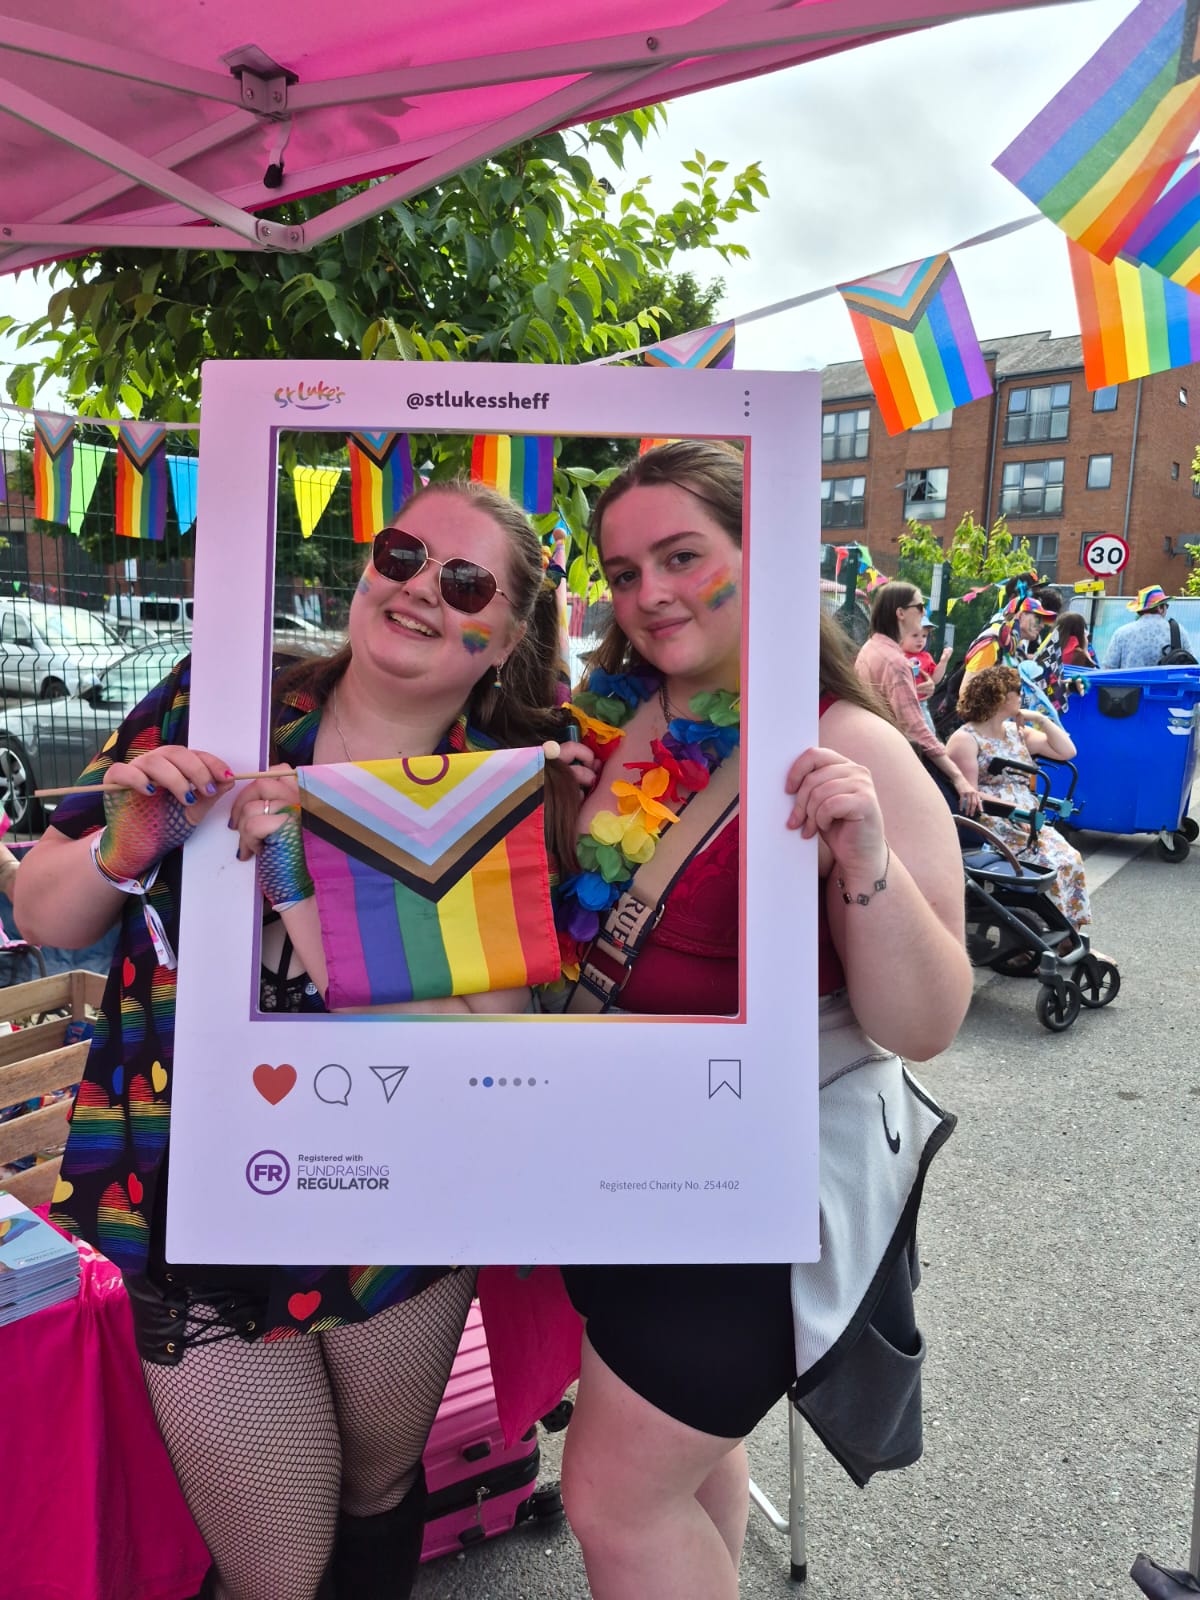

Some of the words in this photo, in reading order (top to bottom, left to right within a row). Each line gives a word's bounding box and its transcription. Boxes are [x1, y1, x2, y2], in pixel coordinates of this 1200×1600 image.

[274, 386, 295, 409] St
[298, 380, 346, 404] Luke's
[406, 390, 550, 410] @stlukessheff
[1090, 546, 1123, 565] 30
[298, 1153, 343, 1163] Registered
[345, 1154, 364, 1162] with
[254, 1164, 283, 1182] FR
[297, 1165, 390, 1177] FUNDRAISING
[297, 1177, 390, 1190] REGULATOR
[600, 1180, 647, 1193] Registered
[649, 1180, 683, 1193] Charity
[685, 1180, 701, 1190] No.
[703, 1180, 740, 1190] 254402
